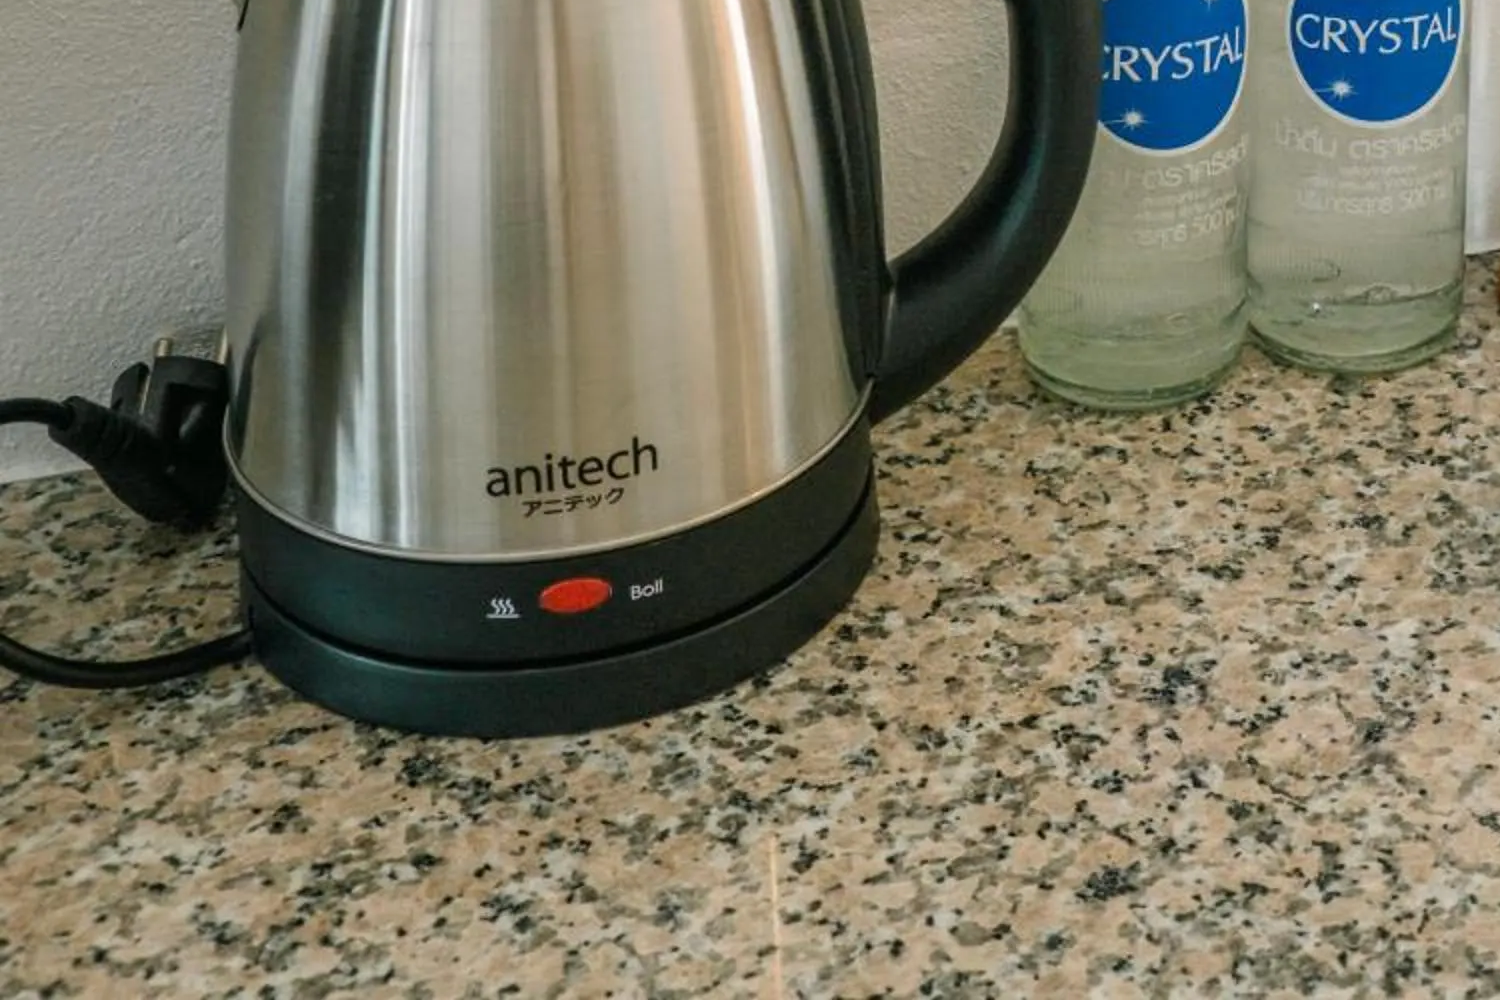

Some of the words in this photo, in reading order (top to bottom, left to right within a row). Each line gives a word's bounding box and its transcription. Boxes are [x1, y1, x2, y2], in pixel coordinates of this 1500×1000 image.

[1295, 7, 1457, 56] CRYSTAL
[486, 436, 659, 497] anitech
[521, 487, 625, 518] アニテック
